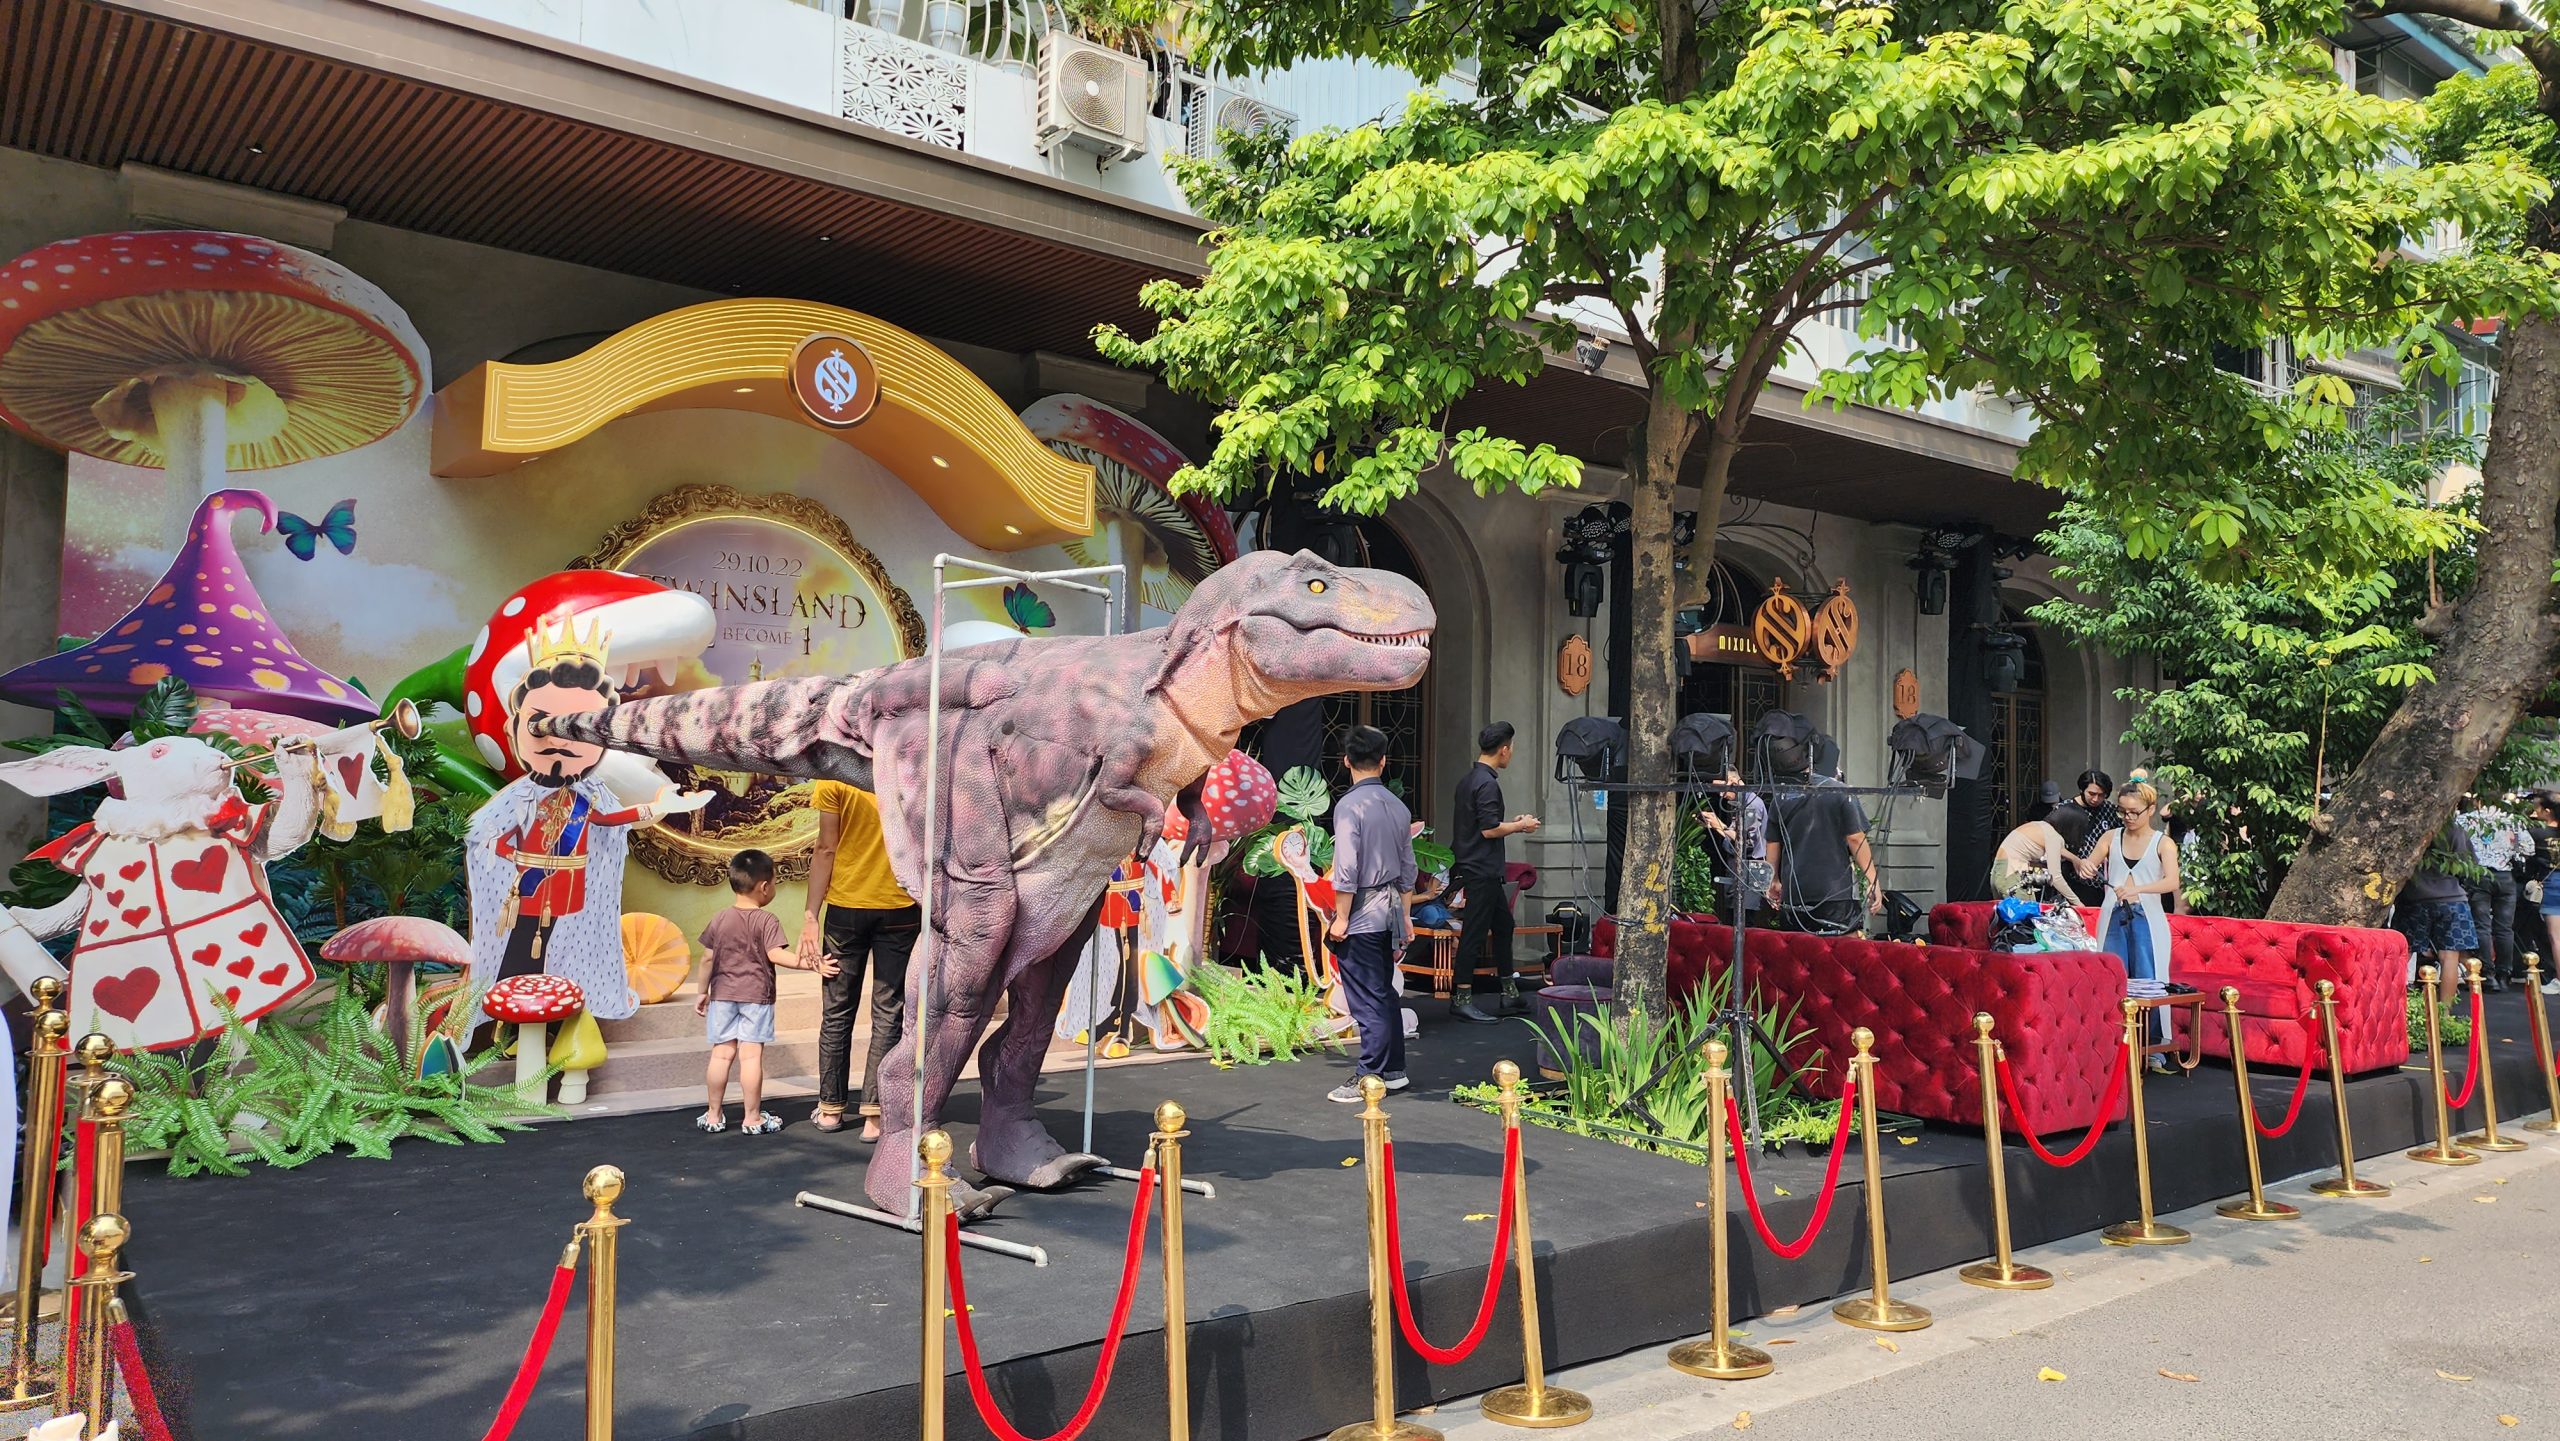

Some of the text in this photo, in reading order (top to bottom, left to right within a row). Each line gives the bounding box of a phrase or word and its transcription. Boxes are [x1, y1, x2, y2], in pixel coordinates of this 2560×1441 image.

[713, 551, 803, 578] 29.10.22
[638, 574, 867, 630] INSLAND
[723, 624, 811, 655] BECOME 1
[1565, 653, 1587, 677] 18
[1898, 684, 1916, 704] 18
